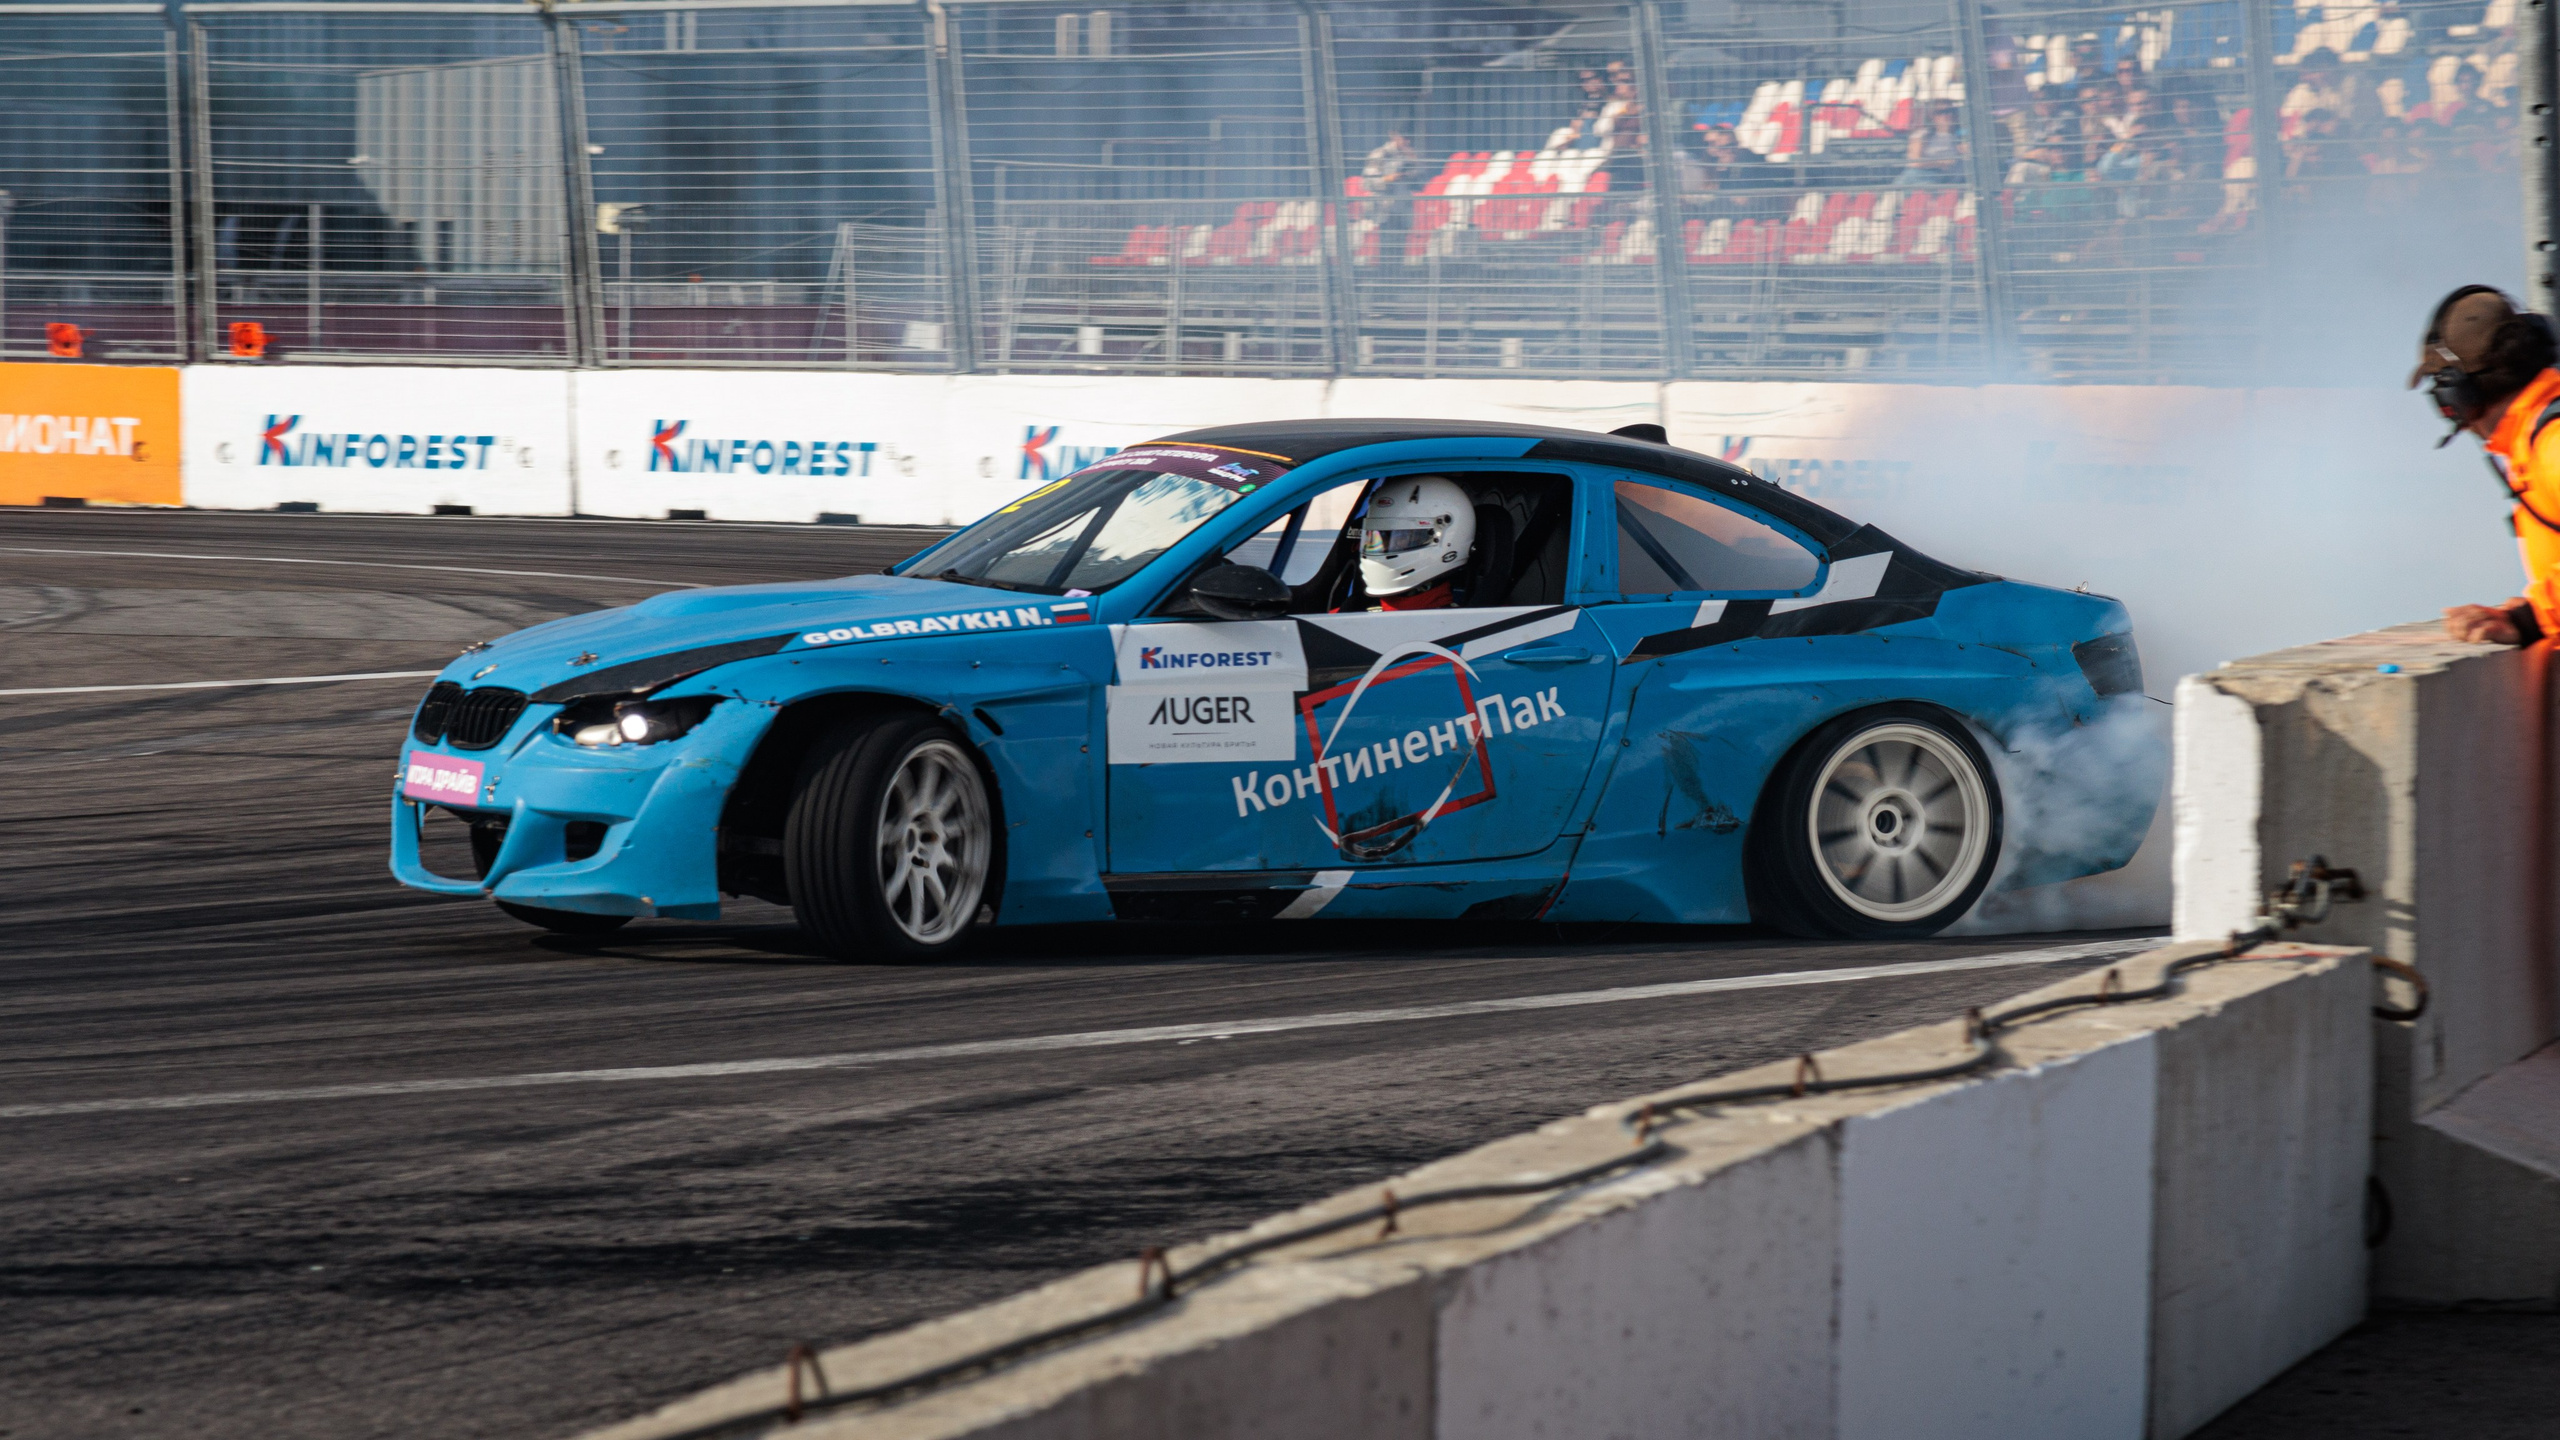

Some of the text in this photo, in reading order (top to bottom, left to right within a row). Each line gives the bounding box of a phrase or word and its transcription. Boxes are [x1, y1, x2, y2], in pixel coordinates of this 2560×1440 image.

[260, 414, 496, 469] KINFOREST
[648, 419, 879, 477] KINFOREST
[803, 607, 1053, 645] GOLBRAYKH N.
[1140, 647, 1273, 670] KINFOREST
[1148, 696, 1255, 726] AUGER
[1231, 686, 1567, 818] КонтинентПак
